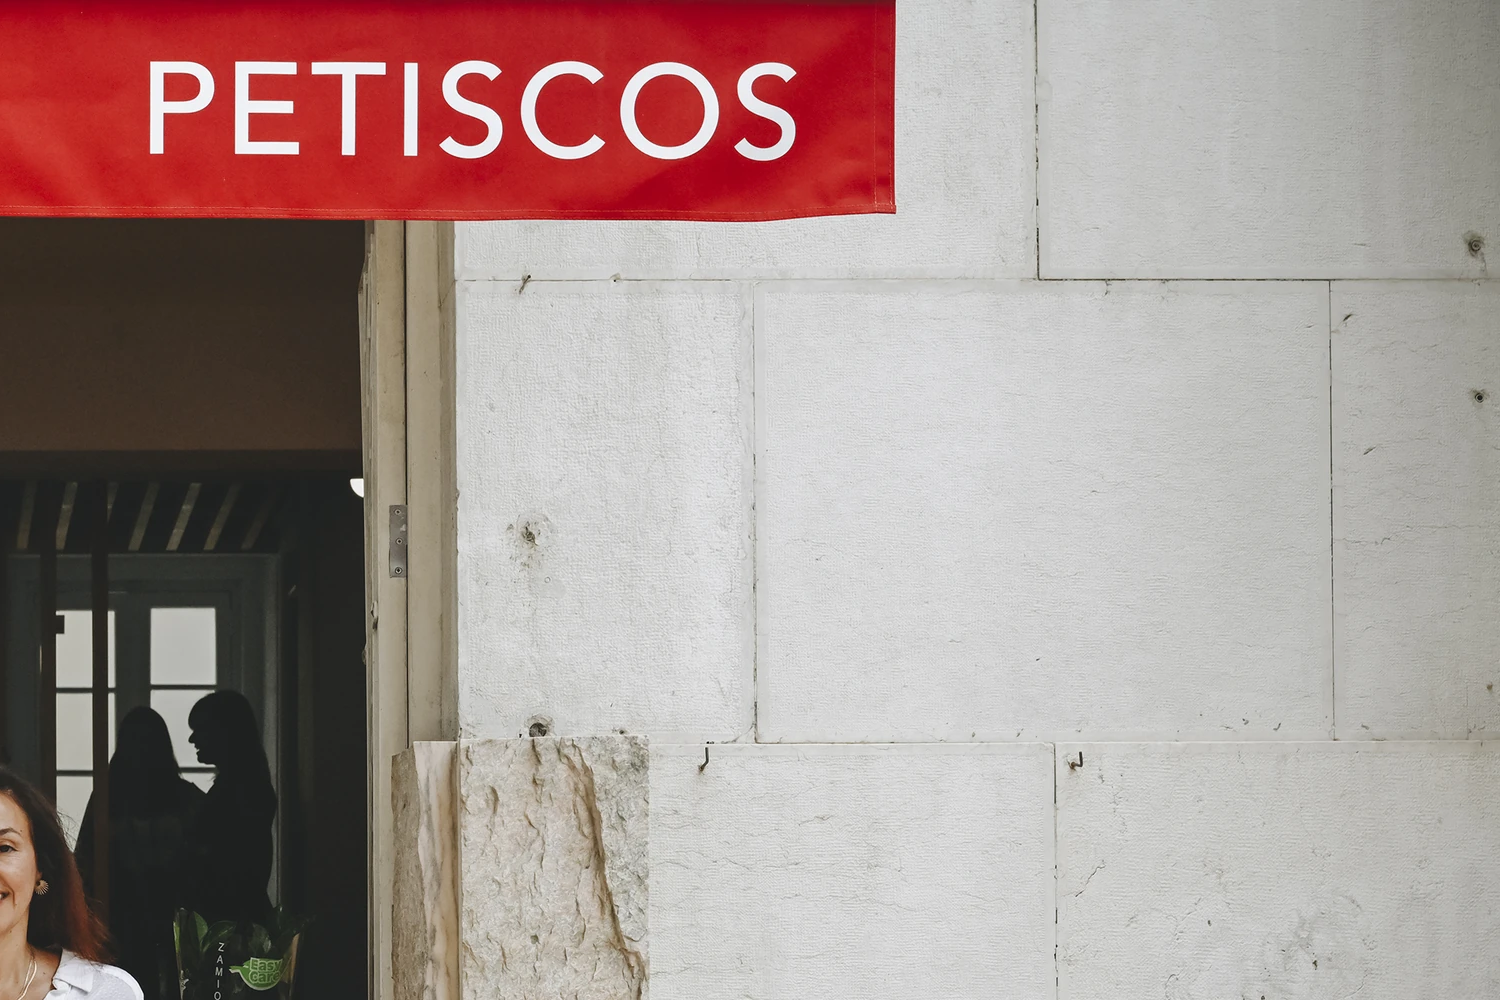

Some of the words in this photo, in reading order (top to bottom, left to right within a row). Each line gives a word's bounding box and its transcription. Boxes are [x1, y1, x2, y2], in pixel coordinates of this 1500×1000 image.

[149, 60, 797, 161] PETISCOS
[250, 958, 282, 972] Easy
[249, 970, 280, 983] Care
